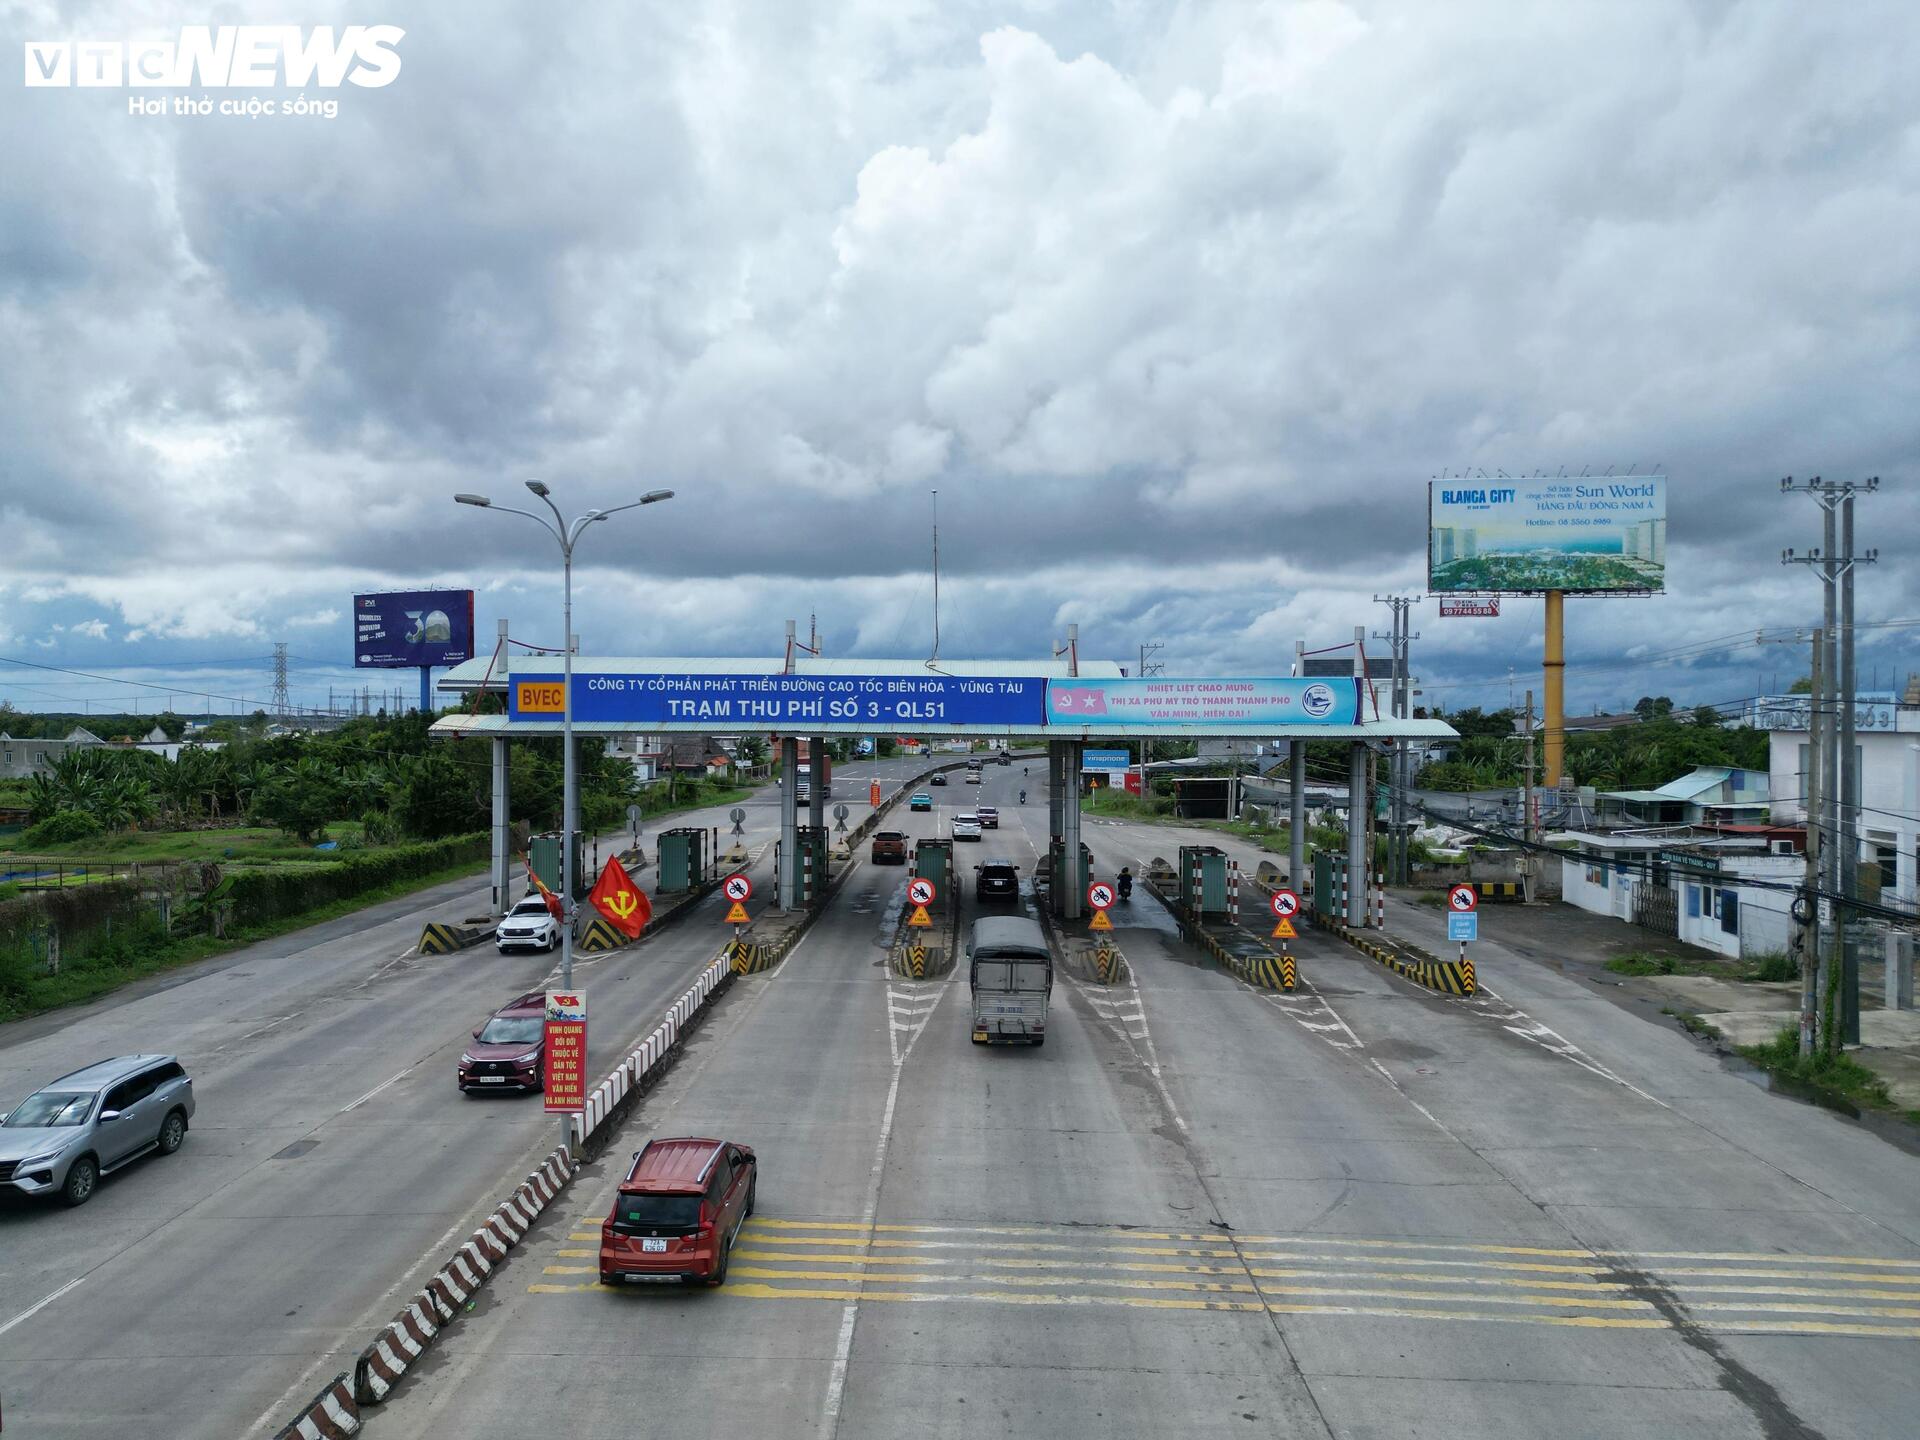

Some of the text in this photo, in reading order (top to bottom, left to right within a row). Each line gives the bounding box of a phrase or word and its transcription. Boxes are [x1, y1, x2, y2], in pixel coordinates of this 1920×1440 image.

[1442, 489, 1515, 504] BLANCA CITY
[1576, 484, 1654, 498] Sun World
[588, 677, 625, 691] CÔNG
[628, 680, 645, 691] TY
[704, 678, 737, 691] PHÁT
[741, 676, 777, 691] TRIỂN
[781, 678, 825, 692] ĐƯỜNG
[829, 681, 854, 692] CAO
[859, 678, 883, 692] TỐC
[888, 679, 915, 692] BIÊN
[920, 679, 945, 693] HÒA
[960, 680, 994, 693] VŨNG
[998, 681, 1023, 694] TÀU
[523, 688, 561, 706] BVEC
[668, 700, 730, 719] TRẠM
[737, 700, 780, 716] THU
[788, 696, 824, 716] PHÍ
[829, 695, 858, 717] SỐ
[868, 702, 879, 717] 3
[896, 701, 945, 718] QL51
[549, 1026, 582, 1034] VINH QUANG
[565, 1073, 578, 1081] NAM
[554, 1096, 566, 1104] ANH
